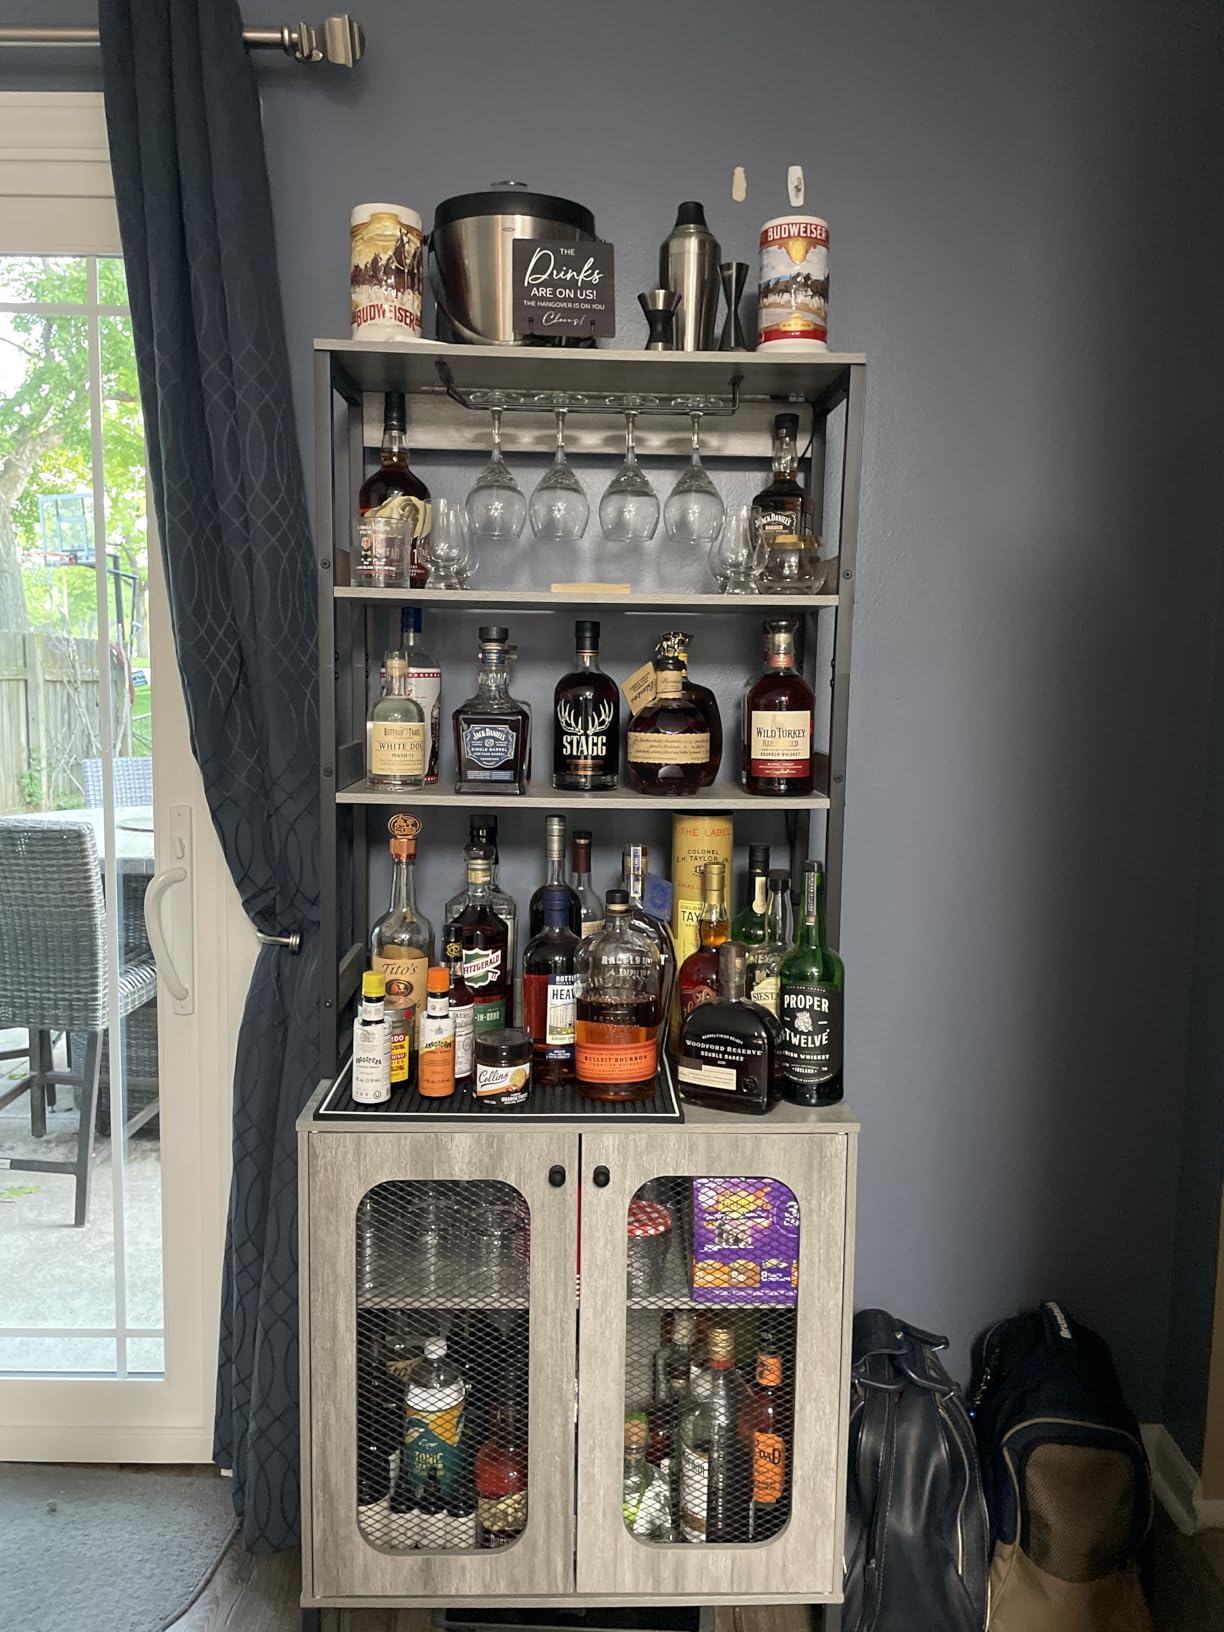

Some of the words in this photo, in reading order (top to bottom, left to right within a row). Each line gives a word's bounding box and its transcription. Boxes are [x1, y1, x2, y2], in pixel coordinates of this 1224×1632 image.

[768, 223, 827, 241] BUDWEISER
[559, 248, 576, 256] THE
[524, 247, 604, 287] Drinks
[530, 287, 554, 298] ARE
[556, 288, 575, 299] ON
[577, 289, 597, 300] US!
[537, 301, 573, 309] HANGOVER
[580, 302, 591, 310] ON
[592, 303, 605, 311] YOU
[356, 303, 416, 332] BUDWEISER
[473, 730, 486, 741] JACK
[756, 727, 777, 739] WILD
[776, 727, 806, 740] TURKEY
[378, 742, 407, 751] WHITE
[562, 734, 607, 757] STAGG
[681, 827, 698, 837] THE
[681, 910, 701, 923] TAY
[382, 962, 418, 976] Tito's
[784, 994, 829, 1013] PROPER
[784, 1027, 829, 1048] TWELVE
[425, 1040, 452, 1049] ANGOSTURA
[685, 1039, 725, 1052] WOODFORD
[726, 1046, 764, 1056] RESERVE
[355, 1056, 382, 1065] ANGOSTURA
[614, 1054, 648, 1063] BOURBON
[700, 1050, 722, 1059] DOUBLE
